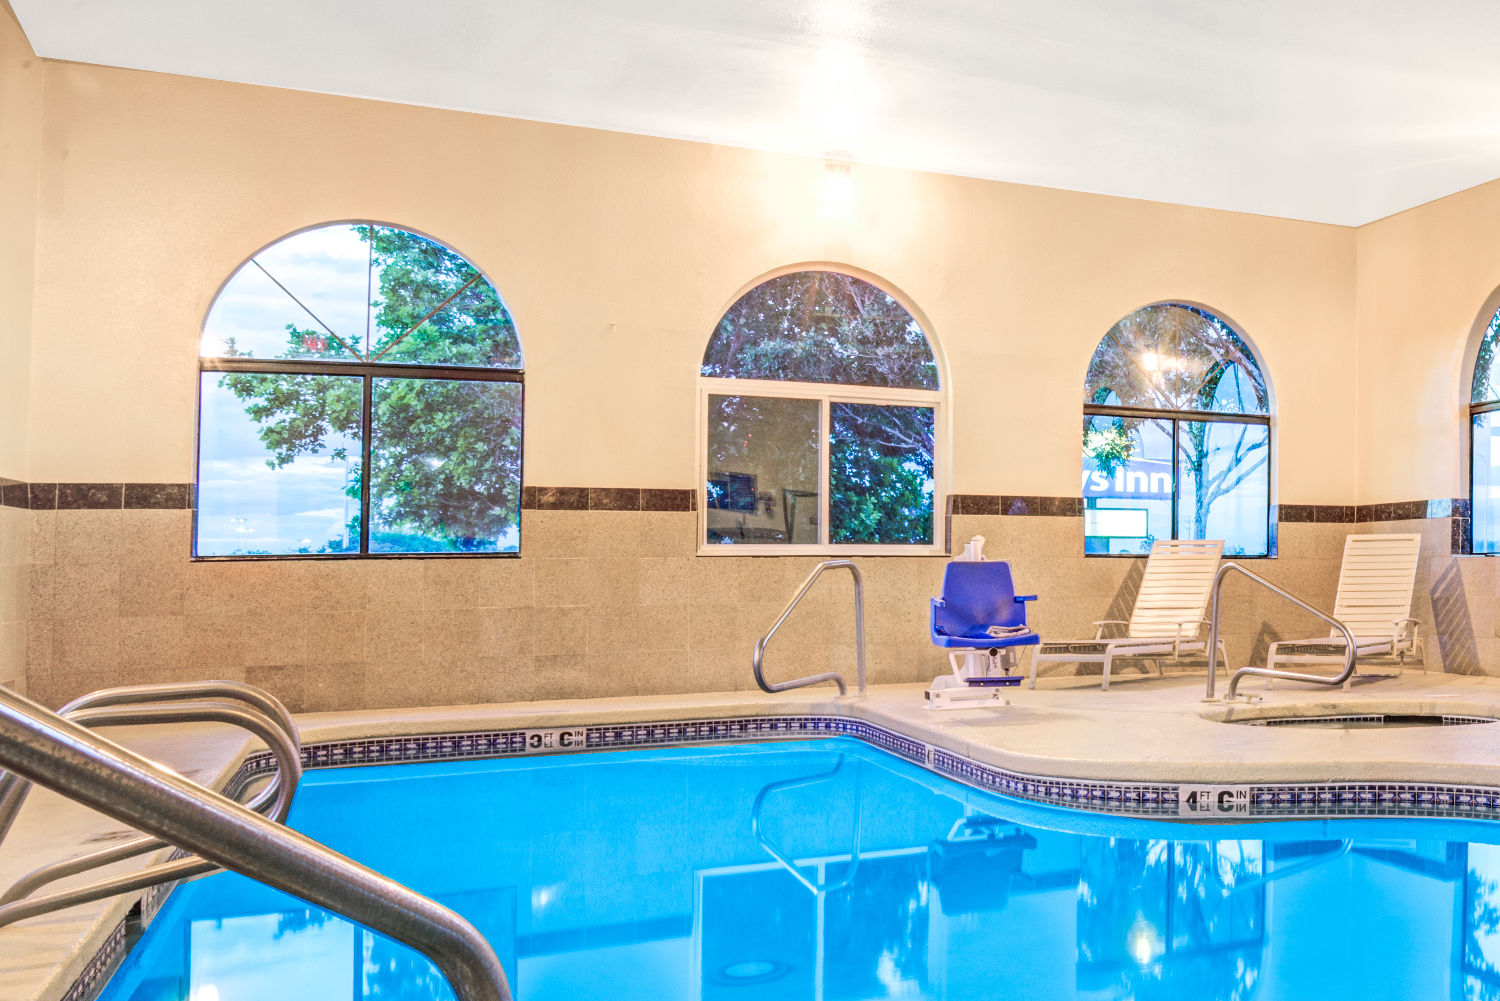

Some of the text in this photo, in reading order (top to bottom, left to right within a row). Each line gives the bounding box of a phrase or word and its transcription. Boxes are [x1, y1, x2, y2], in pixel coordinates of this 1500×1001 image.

[1115, 466, 1171, 493] Inn
[574, 730, 584, 738] IN
[1200, 791, 1211, 800] FT
[1236, 790, 1247, 799] IN
